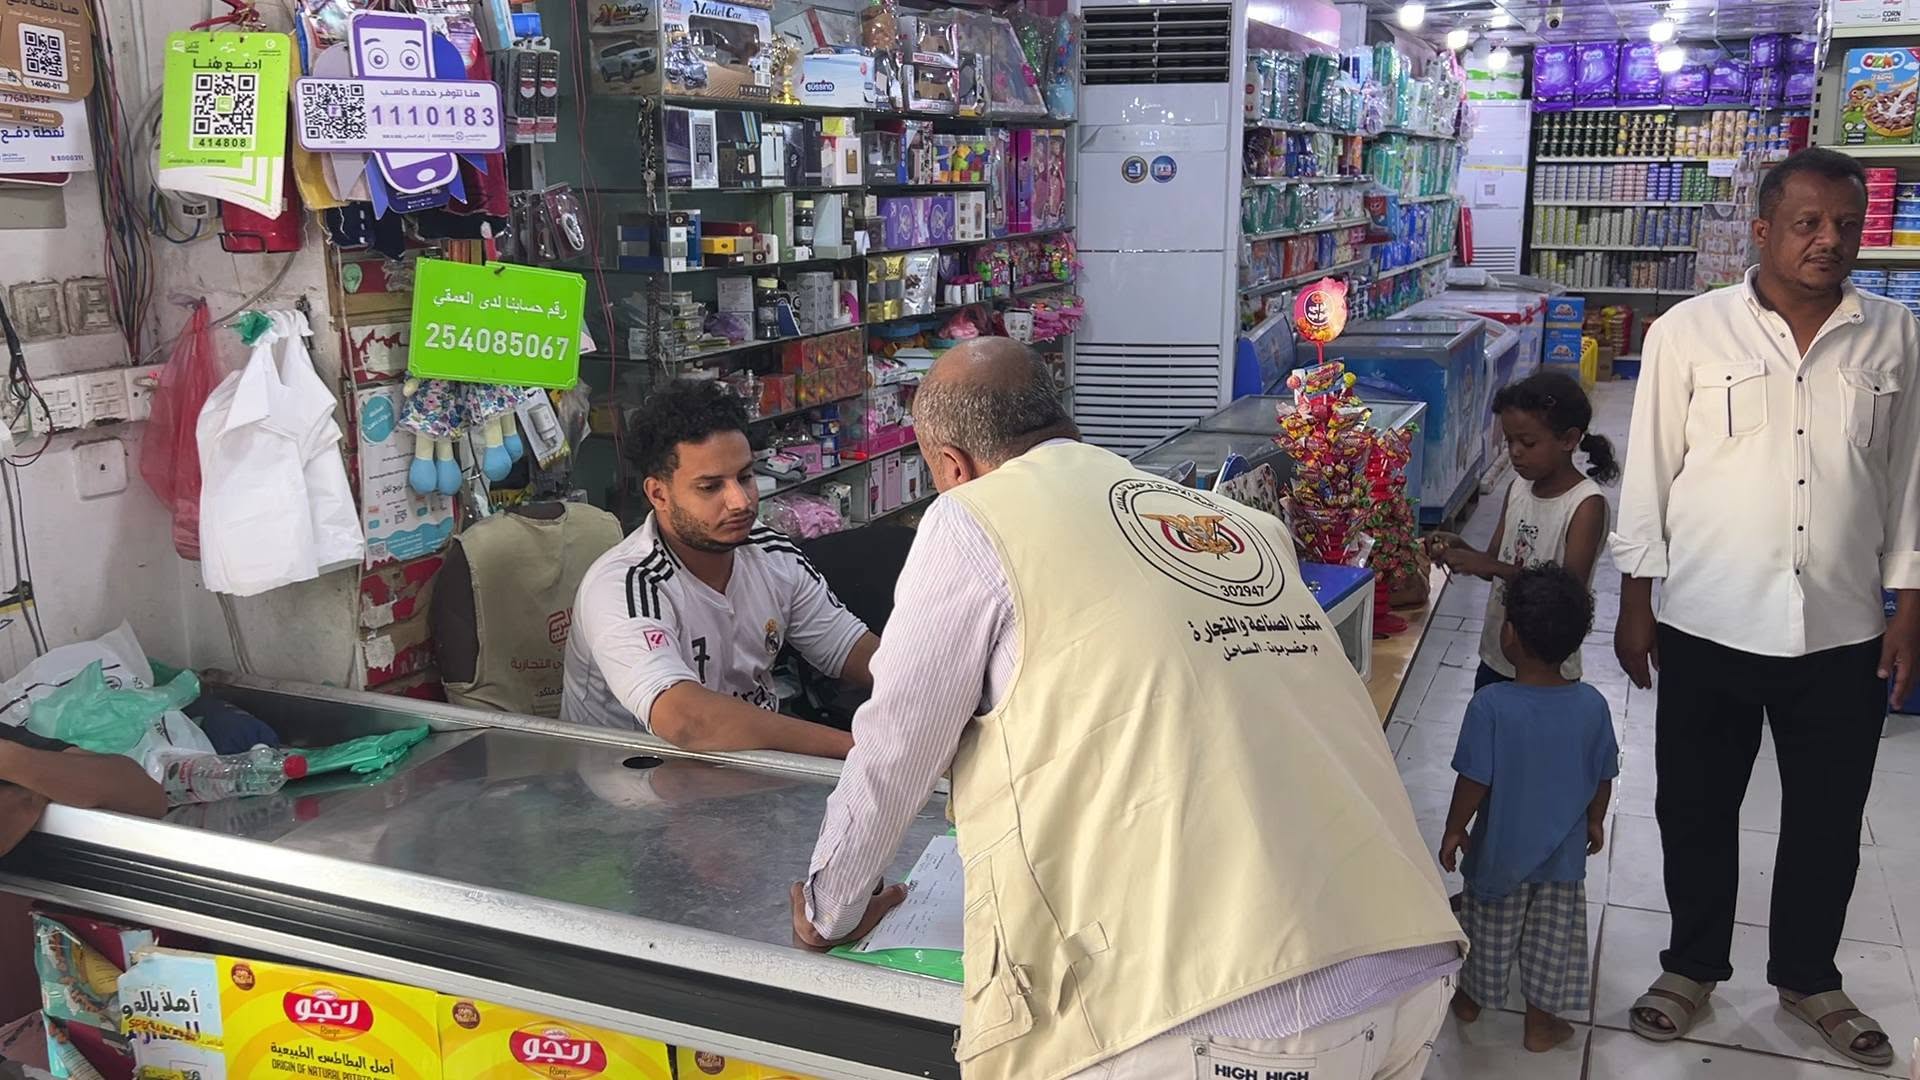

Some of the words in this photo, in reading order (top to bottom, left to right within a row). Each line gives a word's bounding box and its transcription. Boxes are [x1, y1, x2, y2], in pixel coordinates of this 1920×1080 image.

[690, 0, 725, 17] Model
[411, 88, 437, 97] خدمة
[371, 104, 495, 127] 1110183
[1, 126, 30, 144] دفع
[198, 138, 247, 148] 414808
[479, 295, 502, 310] لدى
[505, 297, 544, 314] حسابنا
[547, 301, 568, 320] رقم
[424, 322, 570, 361] 254085067
[1220, 585, 1265, 597] 302947
[1187, 616, 1250, 644] والتجارة
[1244, 614, 1294, 632] الصناعة
[1293, 613, 1322, 635] مكتب
[691, 636, 710, 684] 7
[1223, 641, 1262, 661] الساحل
[295, 999, 359, 1025] رنجو
[270, 1042, 314, 1061] الطبيعية
[521, 1038, 591, 1065] رنجو
[271, 1058, 296, 1072] ORIGIN
[296, 1063, 306, 1074] OF
[307, 1064, 340, 1080] NATURAL
[317, 1051, 367, 1072] البطاطس
[1215, 1064, 1258, 1080] HIGH
[1266, 1071, 1309, 1080] HIGH
